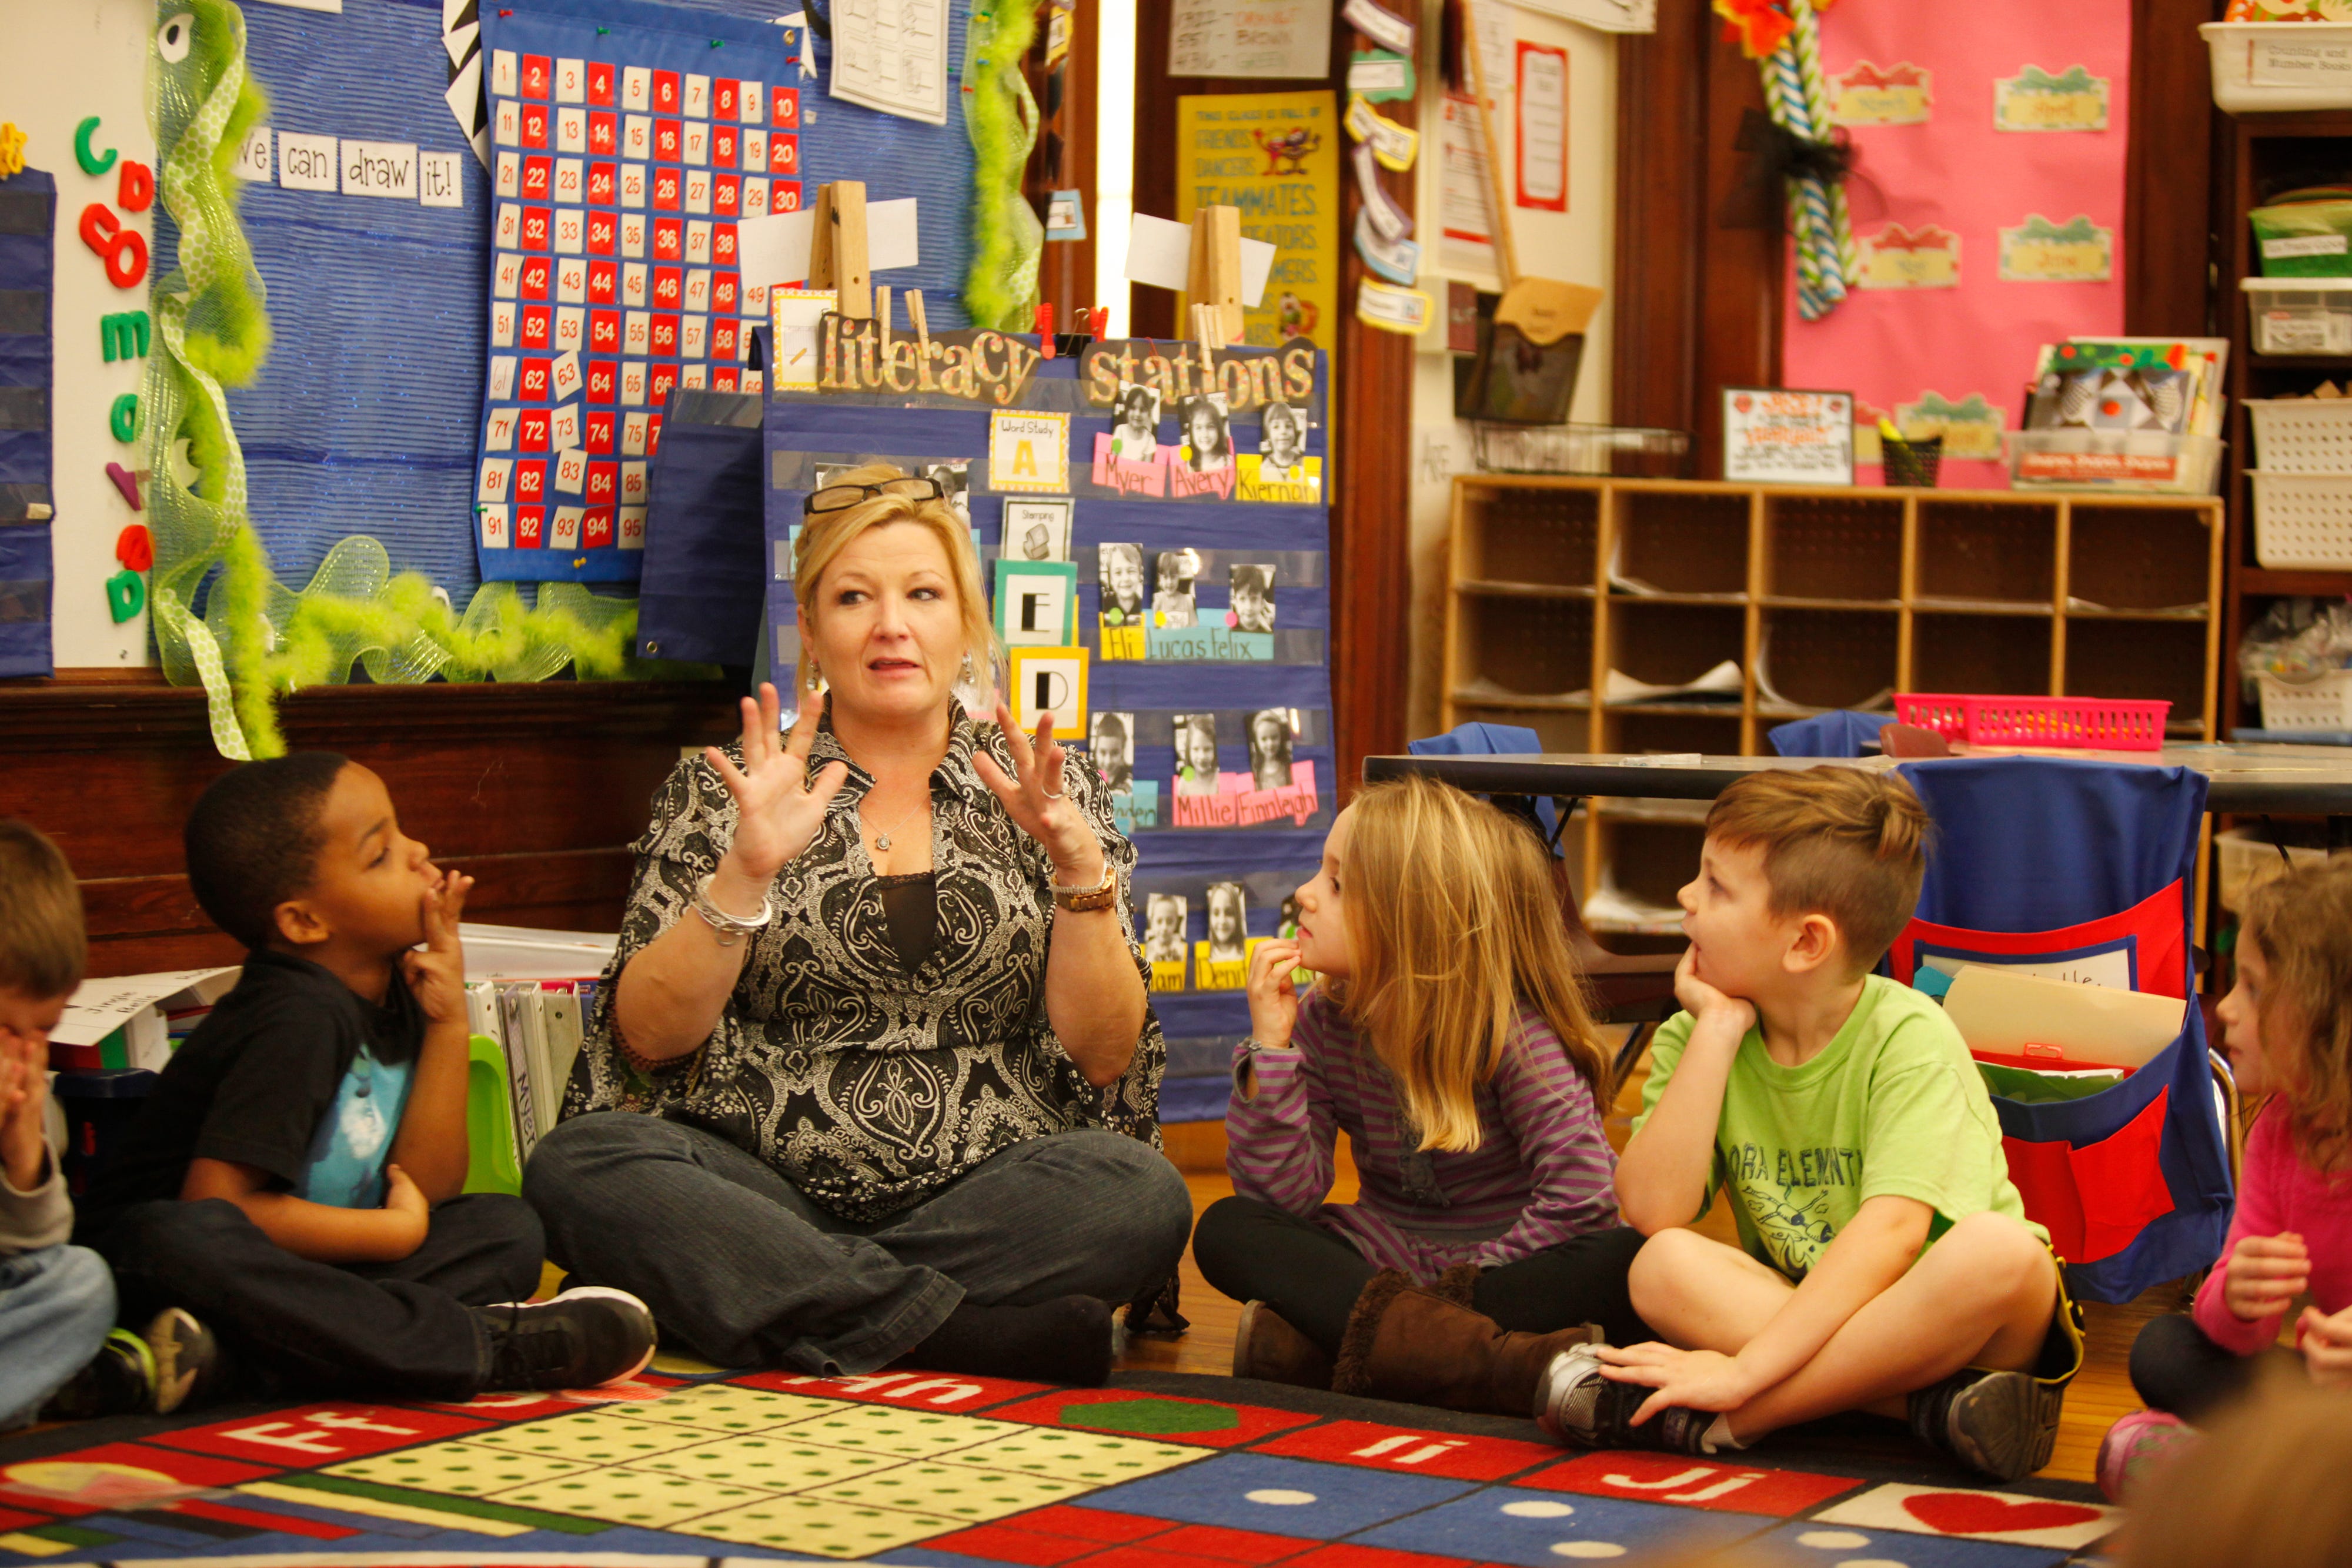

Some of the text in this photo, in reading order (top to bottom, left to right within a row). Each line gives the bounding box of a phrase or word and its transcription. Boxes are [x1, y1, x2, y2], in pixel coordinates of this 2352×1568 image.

[502, 64, 793, 117] 1 2 3 4 5 6 7 8 9 10
[503, 113, 794, 163] 11 12 13 14 15 16 17 18 19 20
[288, 148, 327, 178] can
[349, 148, 409, 188] draw
[426, 161, 453, 196] it!
[502, 165, 797, 210] 21 22 23 24 25 26 27 28 29 30
[503, 216, 734, 253] 31 32 33 34 35 36 37 38
[502, 266, 764, 303] 41 42 43 44 45 46 47 48 49
[497, 315, 509, 333] 51
[526, 317, 544, 337] 52
[561, 320, 577, 339] 53
[595, 322, 614, 340] 54
[630, 324, 645, 342] 55
[655, 326, 673, 345] 56
[686, 327, 701, 345] 57
[716, 329, 733, 349] 58
[493, 363, 763, 393] 61 62 63 64 65 66 67 68 69
[820, 315, 1315, 409] literacy stations
[495, 421, 509, 437] 71
[526, 421, 544, 440] 72
[557, 417, 573, 437] 73
[591, 424, 609, 442] 74
[628, 424, 642, 443] 75
[1001, 420, 1054, 439] Word Study
[1012, 439, 1038, 477] A
[1107, 453, 1152, 496] Myer
[487, 461, 642, 493] 81 82 83 84 85
[1177, 469, 1230, 500] Avery
[1238, 469, 1318, 502] Kiernan
[489, 517, 641, 537] 91 92 93 94 95
[1022, 509, 1054, 522] Stamping
[1022, 593, 1051, 631] E
[1109, 627, 1134, 660] Eli
[1148, 626, 1254, 660] Lucas Felix
[1035, 671, 1068, 710] D
[1178, 795, 1232, 824] Millie
[1239, 784, 1317, 823] Finnleigh
[517, 1072, 536, 1146] Myer
